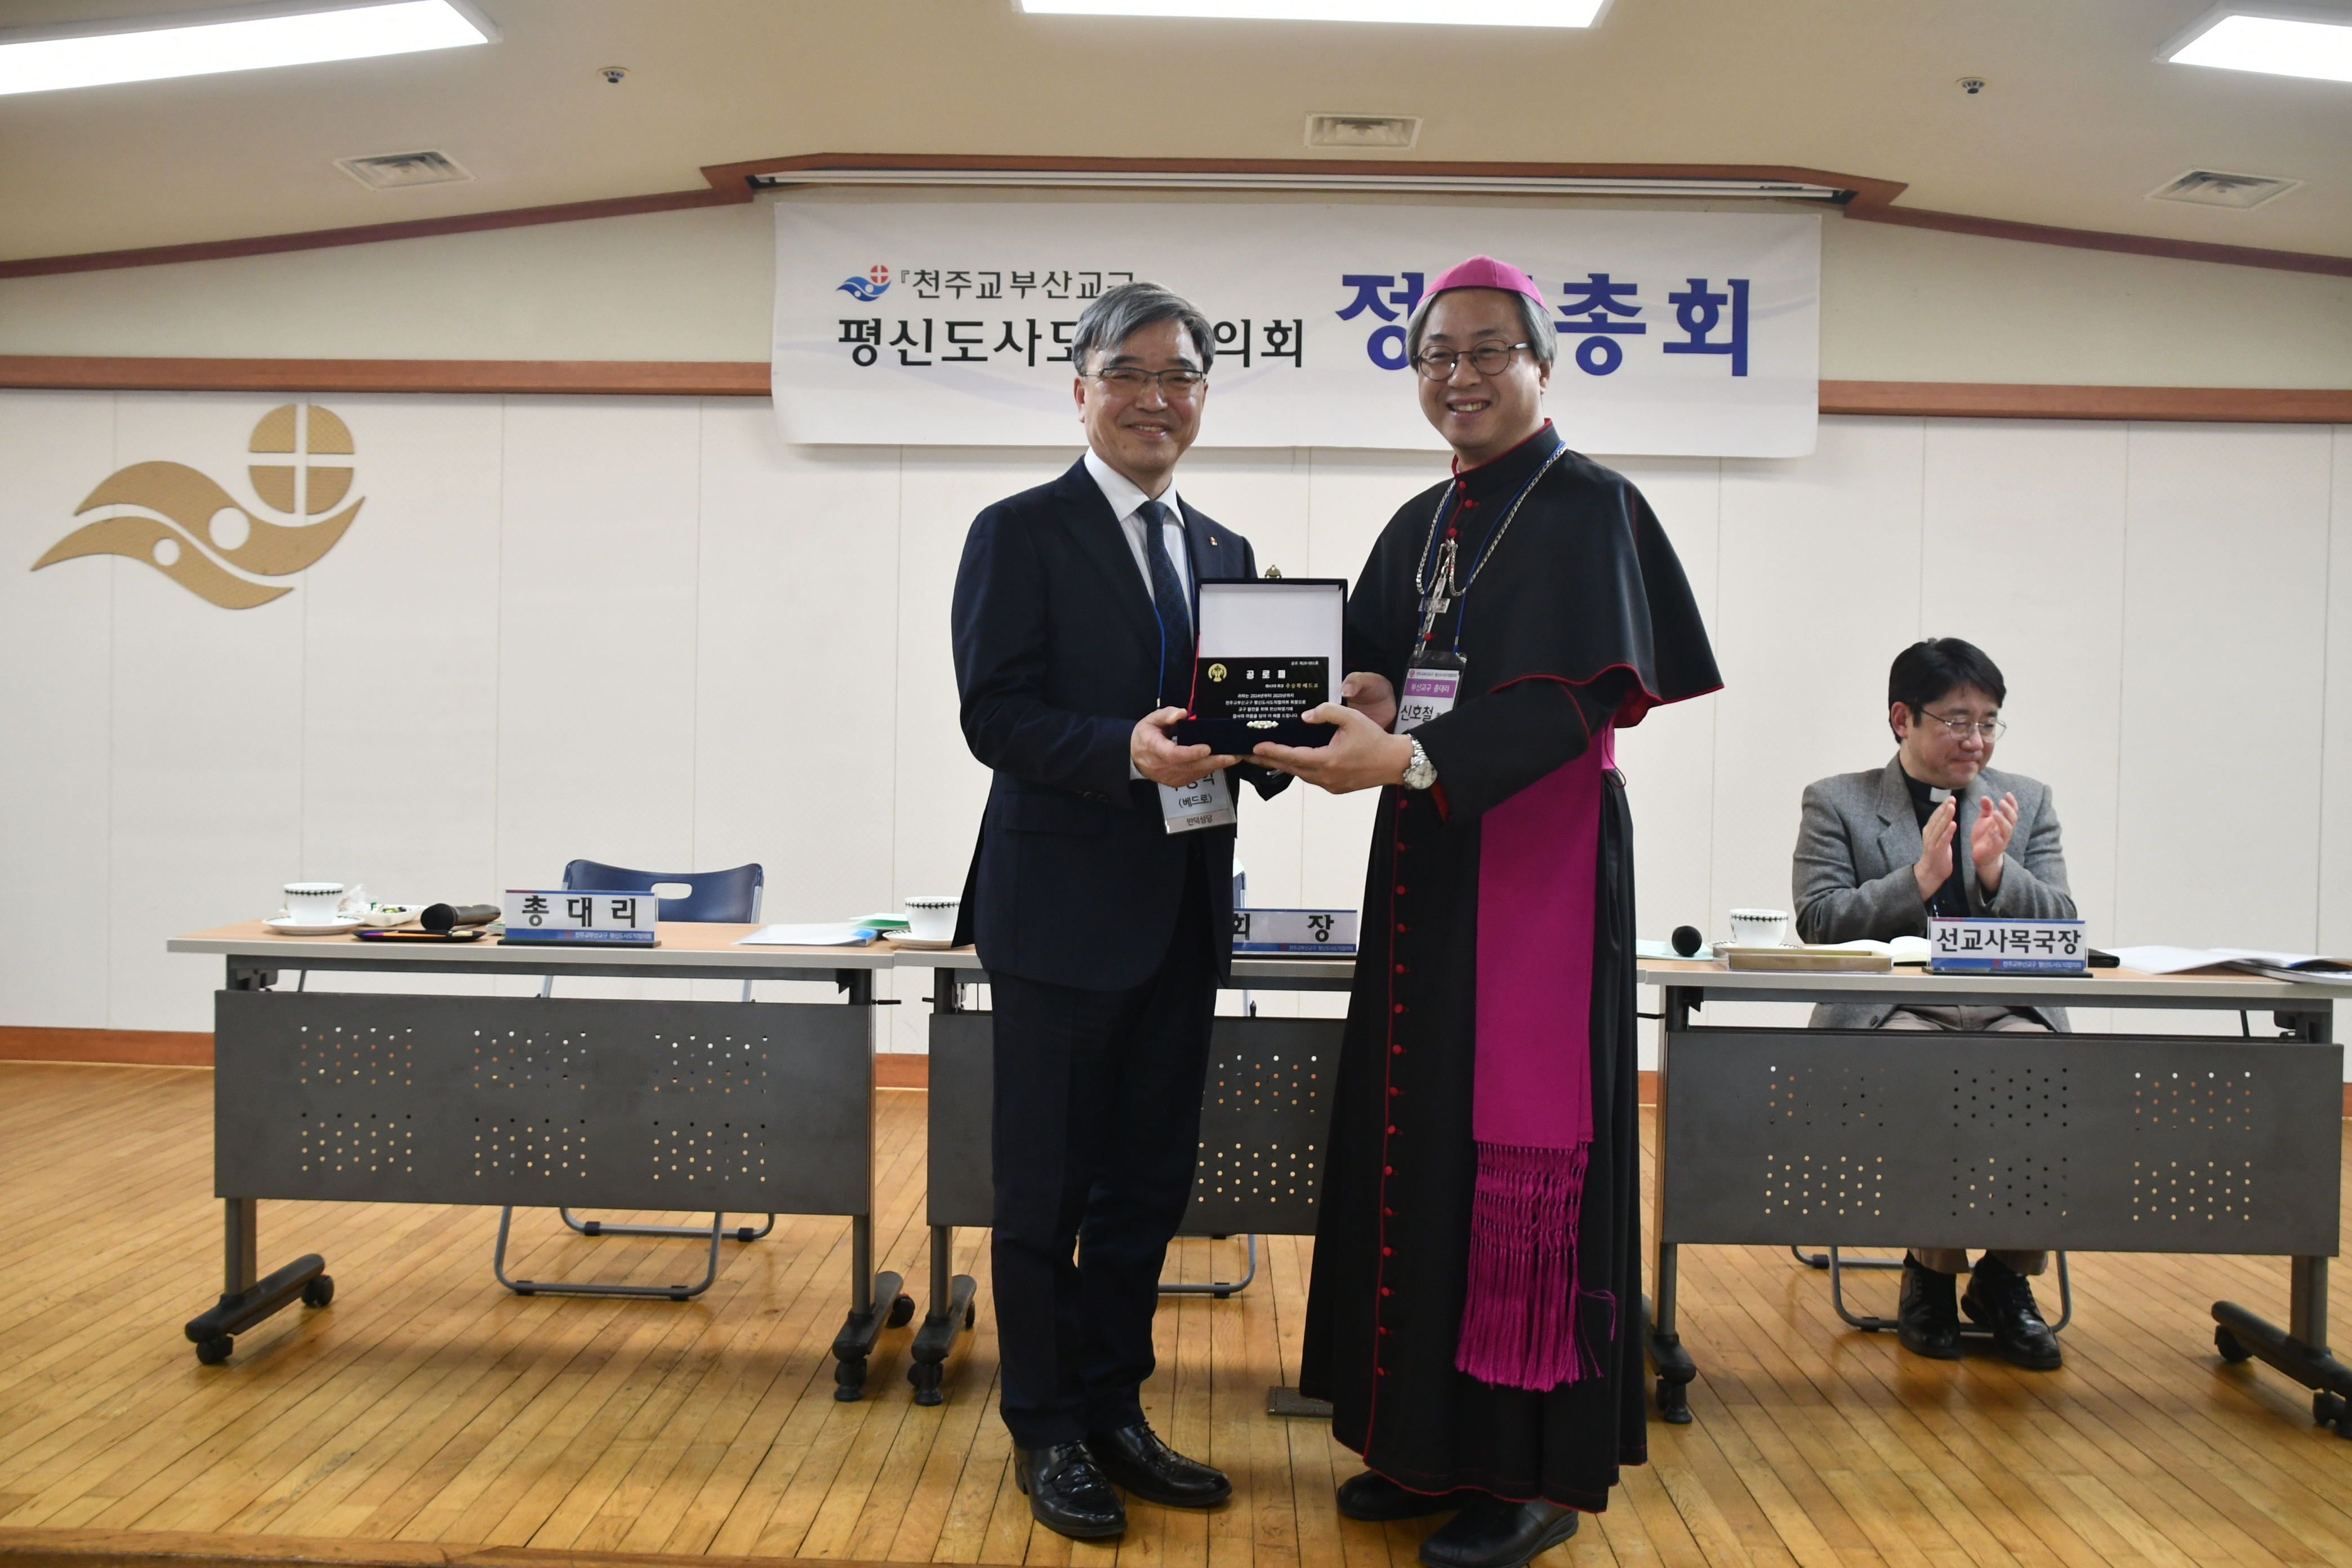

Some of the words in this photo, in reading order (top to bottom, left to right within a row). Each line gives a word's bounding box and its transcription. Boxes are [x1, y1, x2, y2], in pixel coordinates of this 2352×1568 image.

[1411, 683, 1432, 693] 부산교구
[1400, 705, 1434, 722] 신호철
[1187, 814, 1213, 826] 만덕성당
[1936, 928, 2082, 955] 선교사목국장
